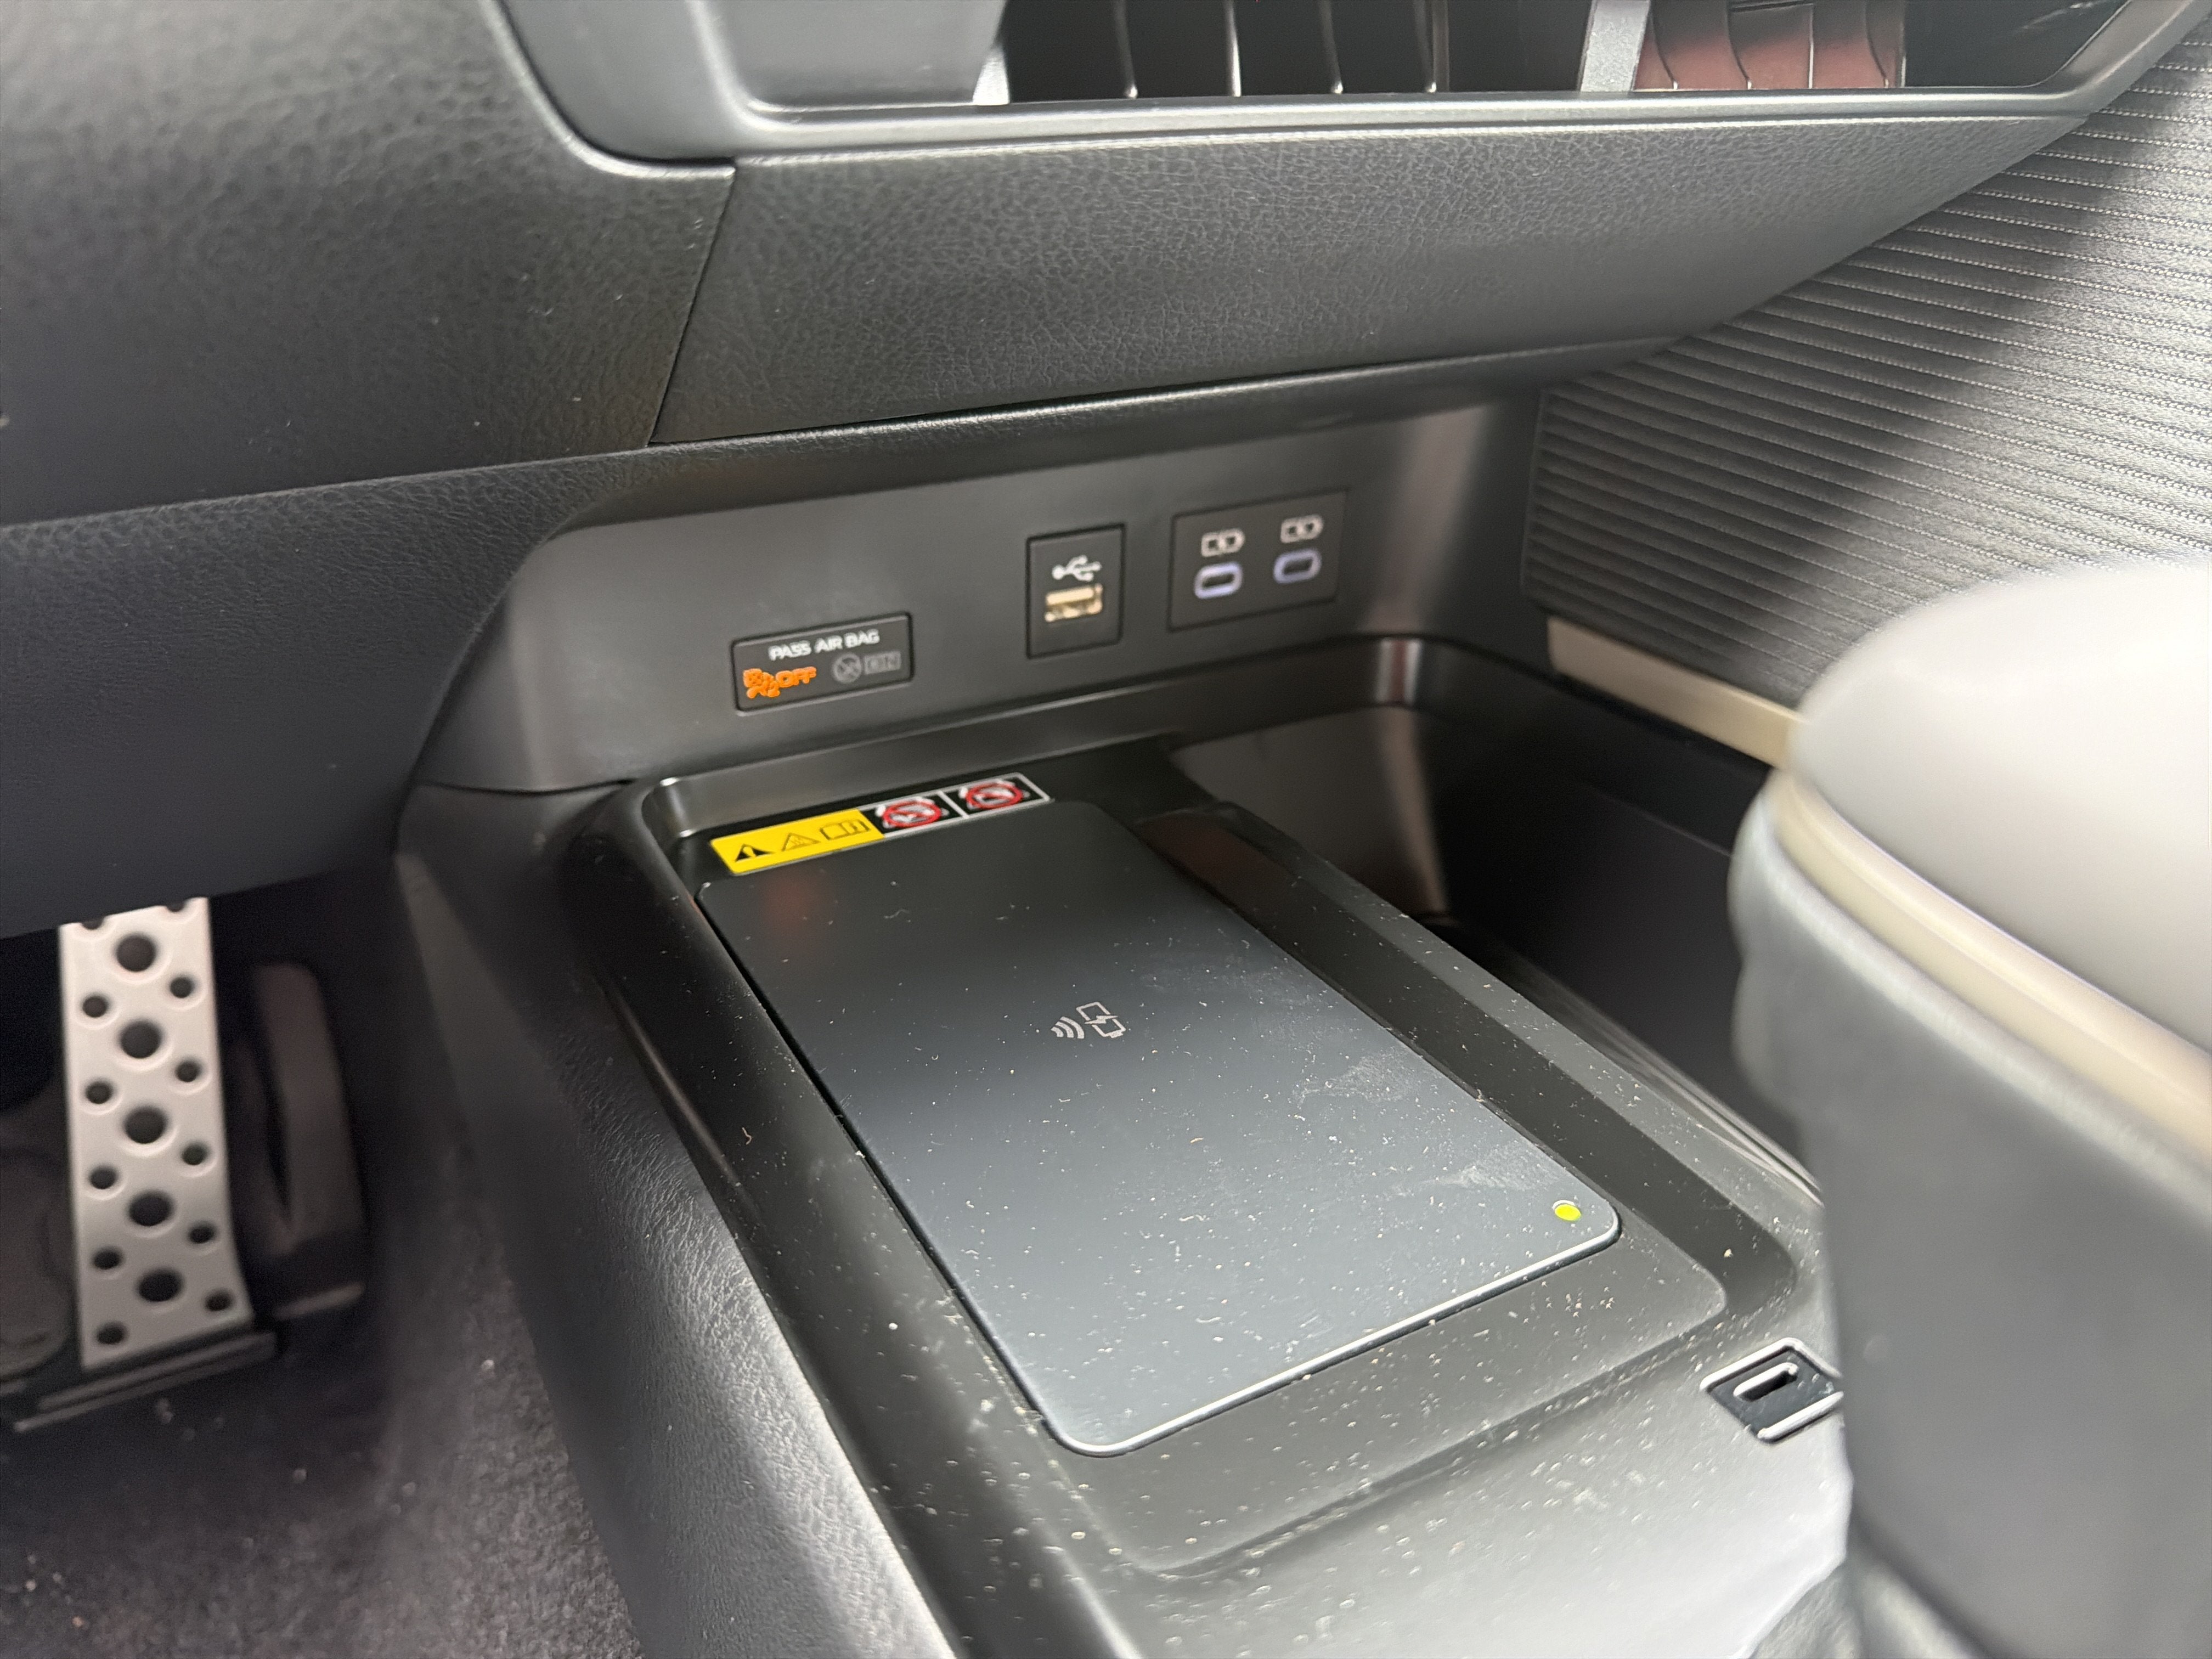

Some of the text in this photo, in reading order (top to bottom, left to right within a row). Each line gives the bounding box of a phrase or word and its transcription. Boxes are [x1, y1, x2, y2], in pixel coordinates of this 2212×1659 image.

[769, 629, 880, 661] PASS AIR BAG
[775, 666, 817, 687] OFF
